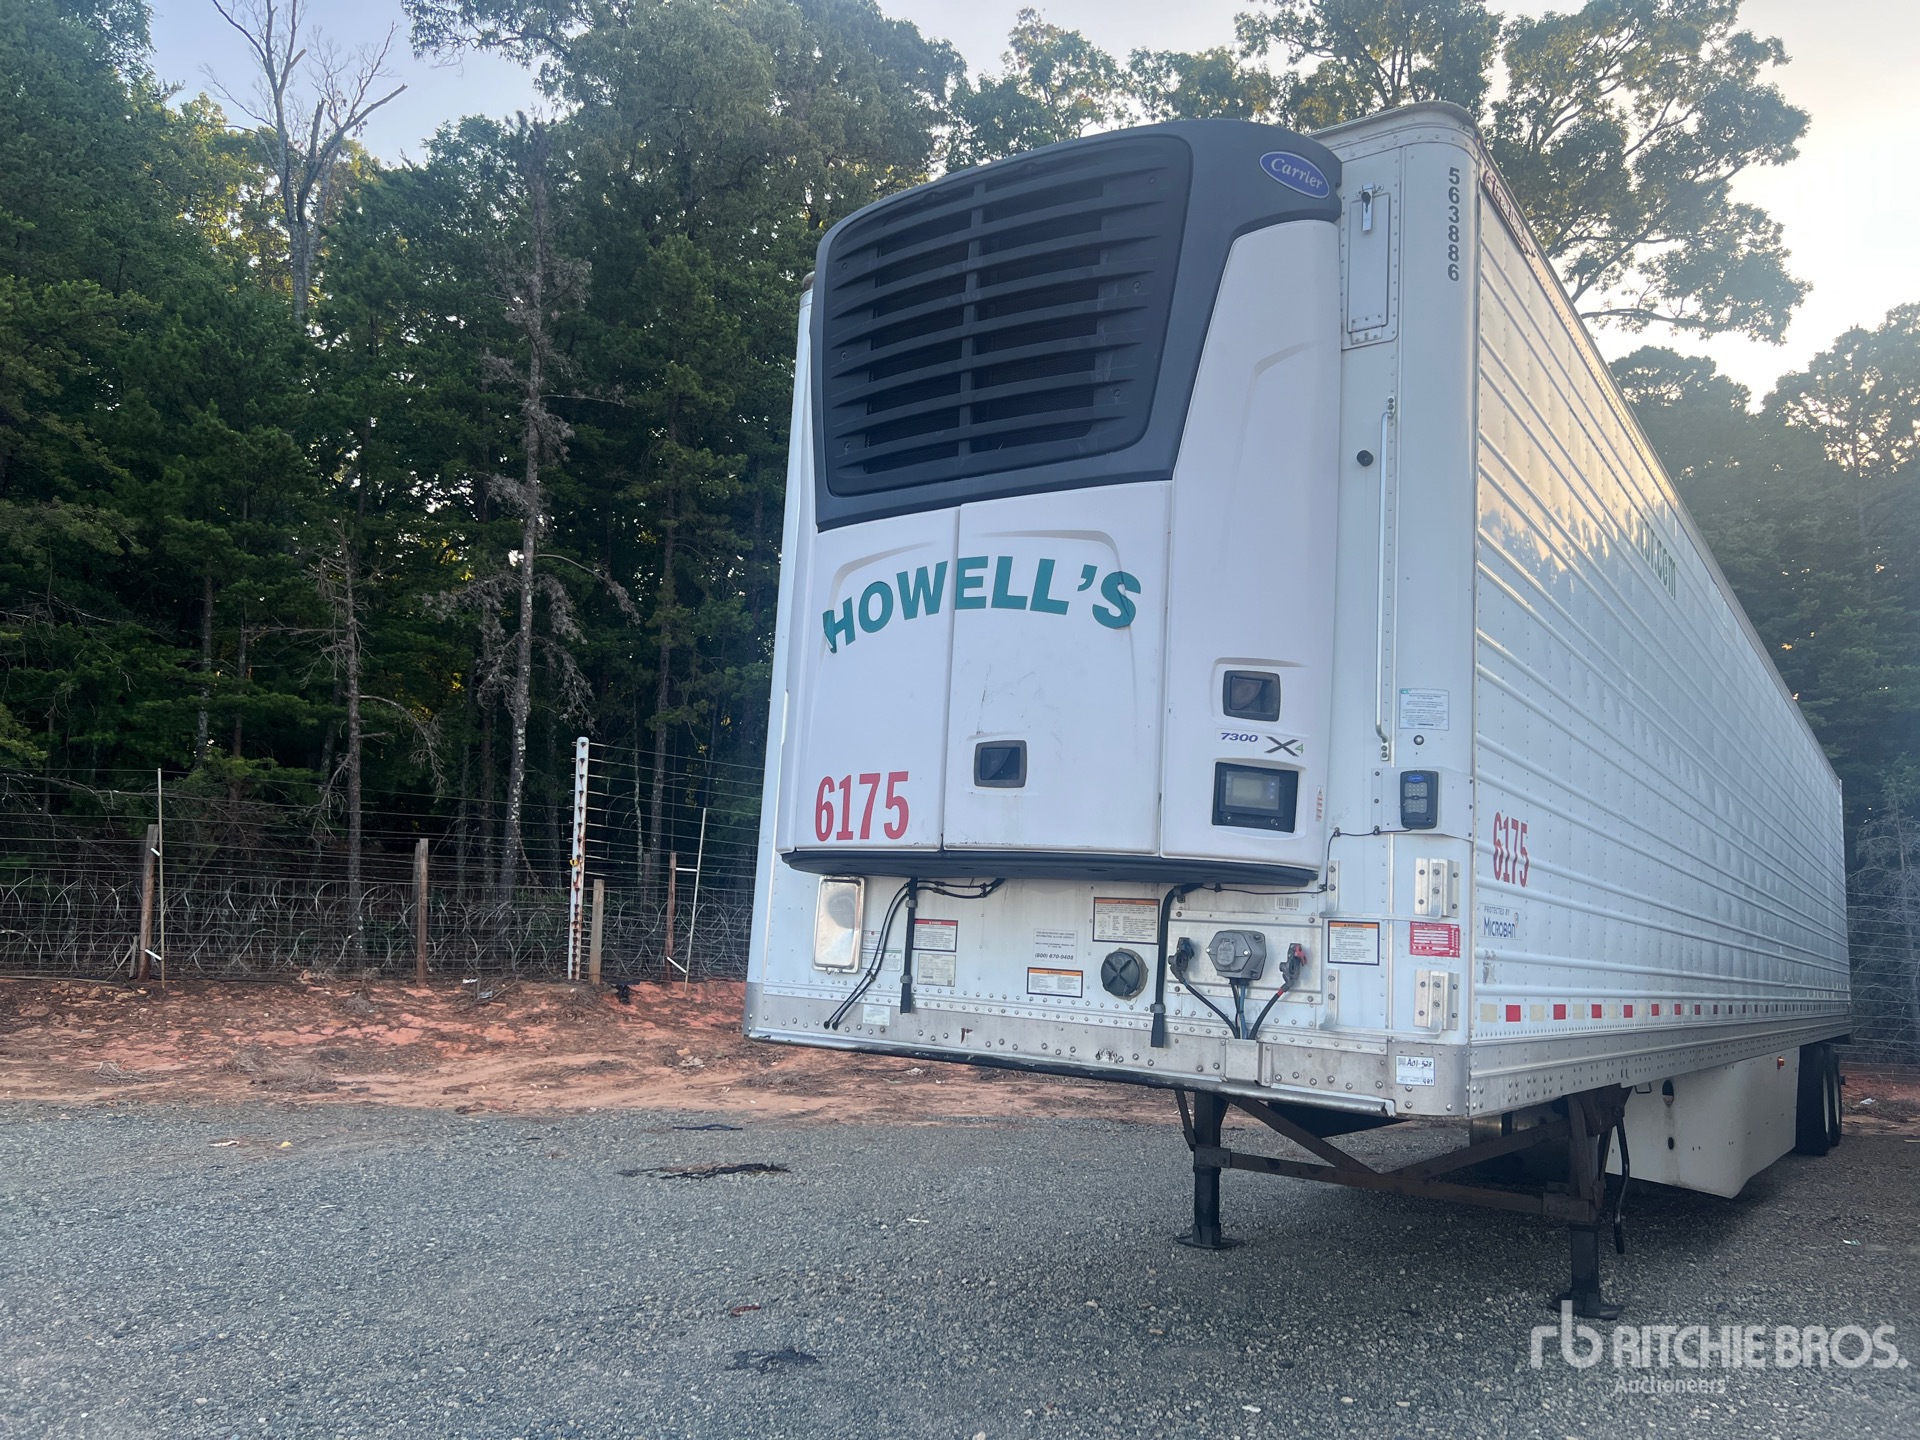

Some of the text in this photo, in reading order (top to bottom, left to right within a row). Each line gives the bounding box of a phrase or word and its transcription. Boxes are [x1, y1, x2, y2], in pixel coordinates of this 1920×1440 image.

[1271, 158, 1323, 189] Carrier
[1447, 166, 1460, 282] 563886
[822, 556, 1142, 654] HOWELL'S
[1220, 732, 1259, 743] 7300
[815, 770, 909, 842] 6175
[1493, 811, 1529, 887] 6175
